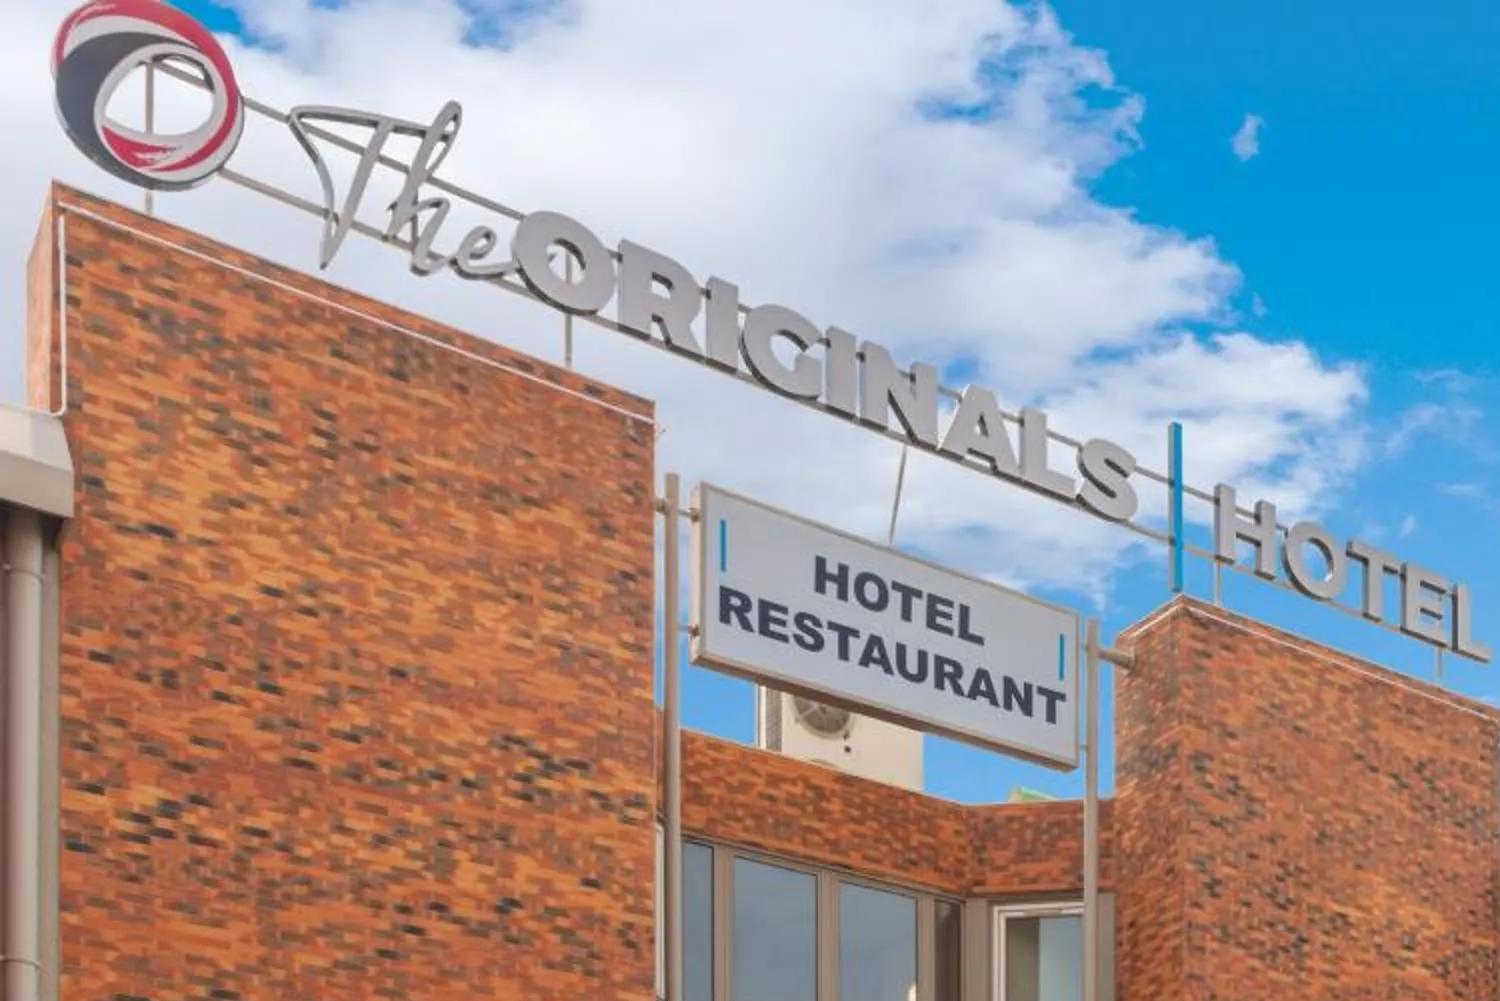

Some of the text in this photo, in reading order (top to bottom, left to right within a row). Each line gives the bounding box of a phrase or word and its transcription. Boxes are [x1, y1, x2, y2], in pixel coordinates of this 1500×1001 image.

[814, 555, 986, 646] HOTEL
[1213, 483, 1491, 664] HOTEL
[718, 585, 1067, 725] RESTAURANT
